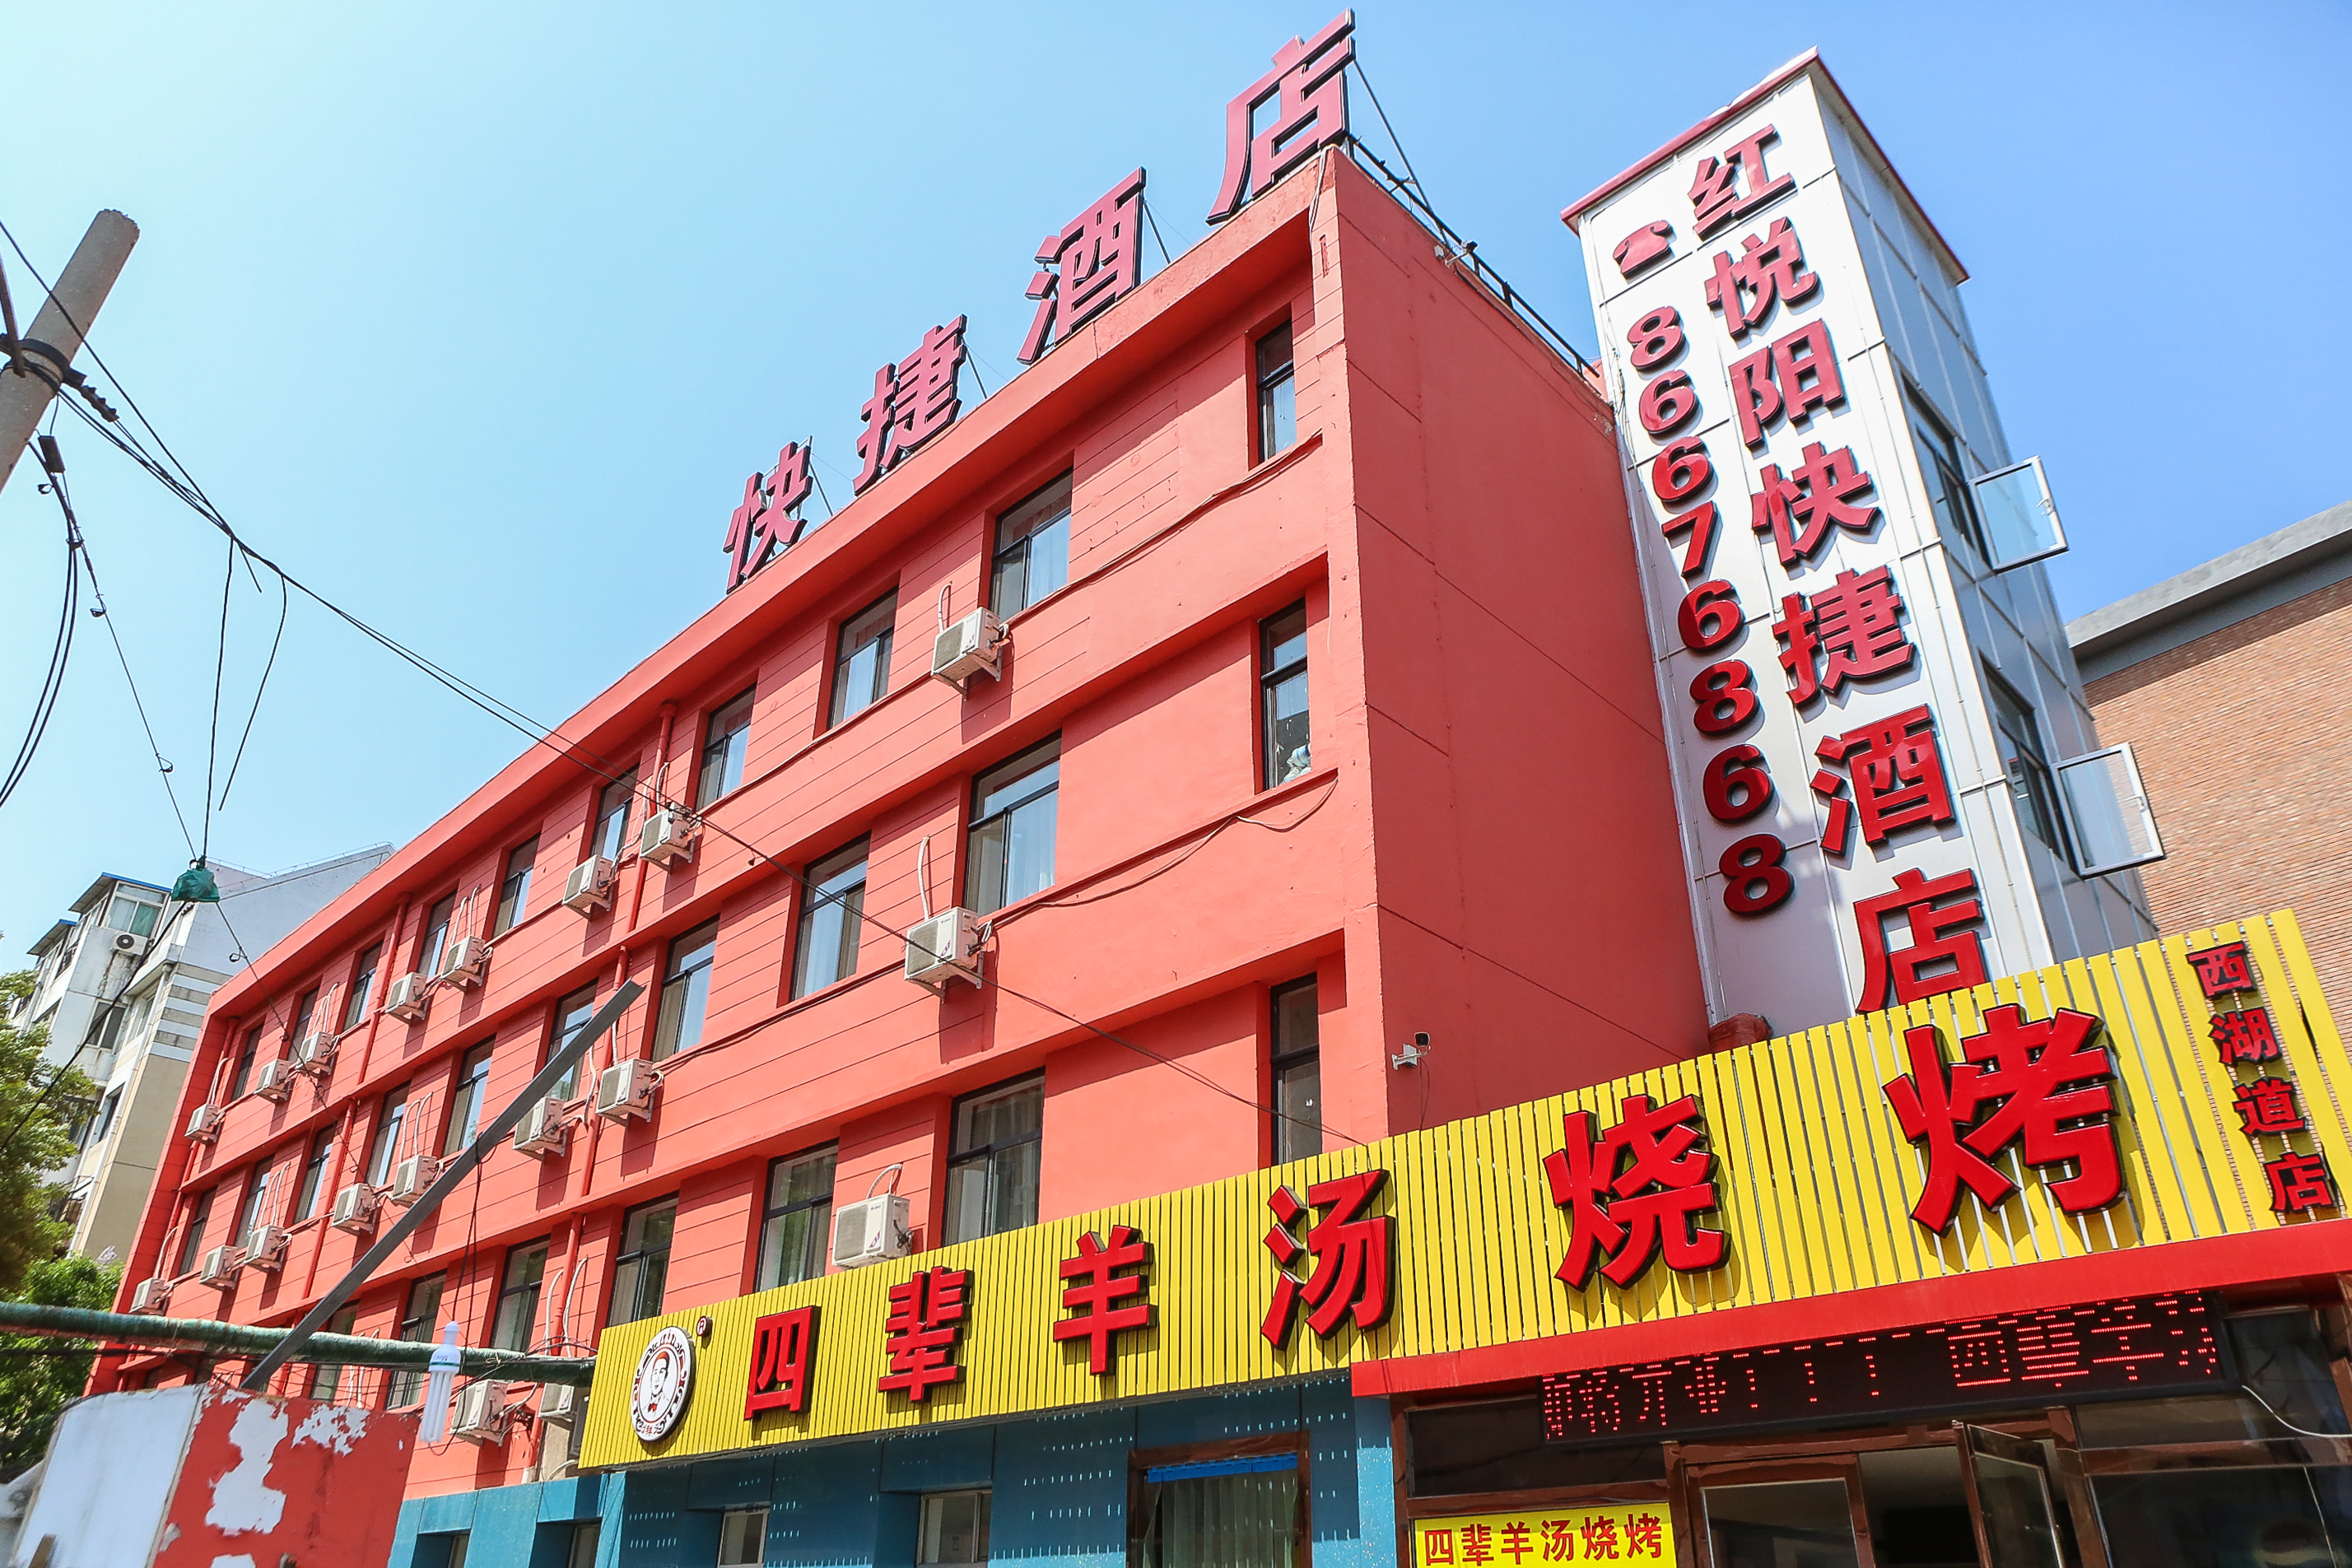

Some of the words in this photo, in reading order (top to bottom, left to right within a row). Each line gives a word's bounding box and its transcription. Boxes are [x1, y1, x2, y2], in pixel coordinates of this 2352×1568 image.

[722, 8, 1356, 595] 快捷酒店
[1627, 305, 1795, 918] 86676868
[1688, 123, 1991, 1014] 红悦阳快捷酒店
[744, 1002, 2126, 1421] 四辈羊汤烧烤
[2186, 941, 2338, 1216] 西湖道店
[1424, 1513, 1662, 1566] 四辈羊汤烧烤
